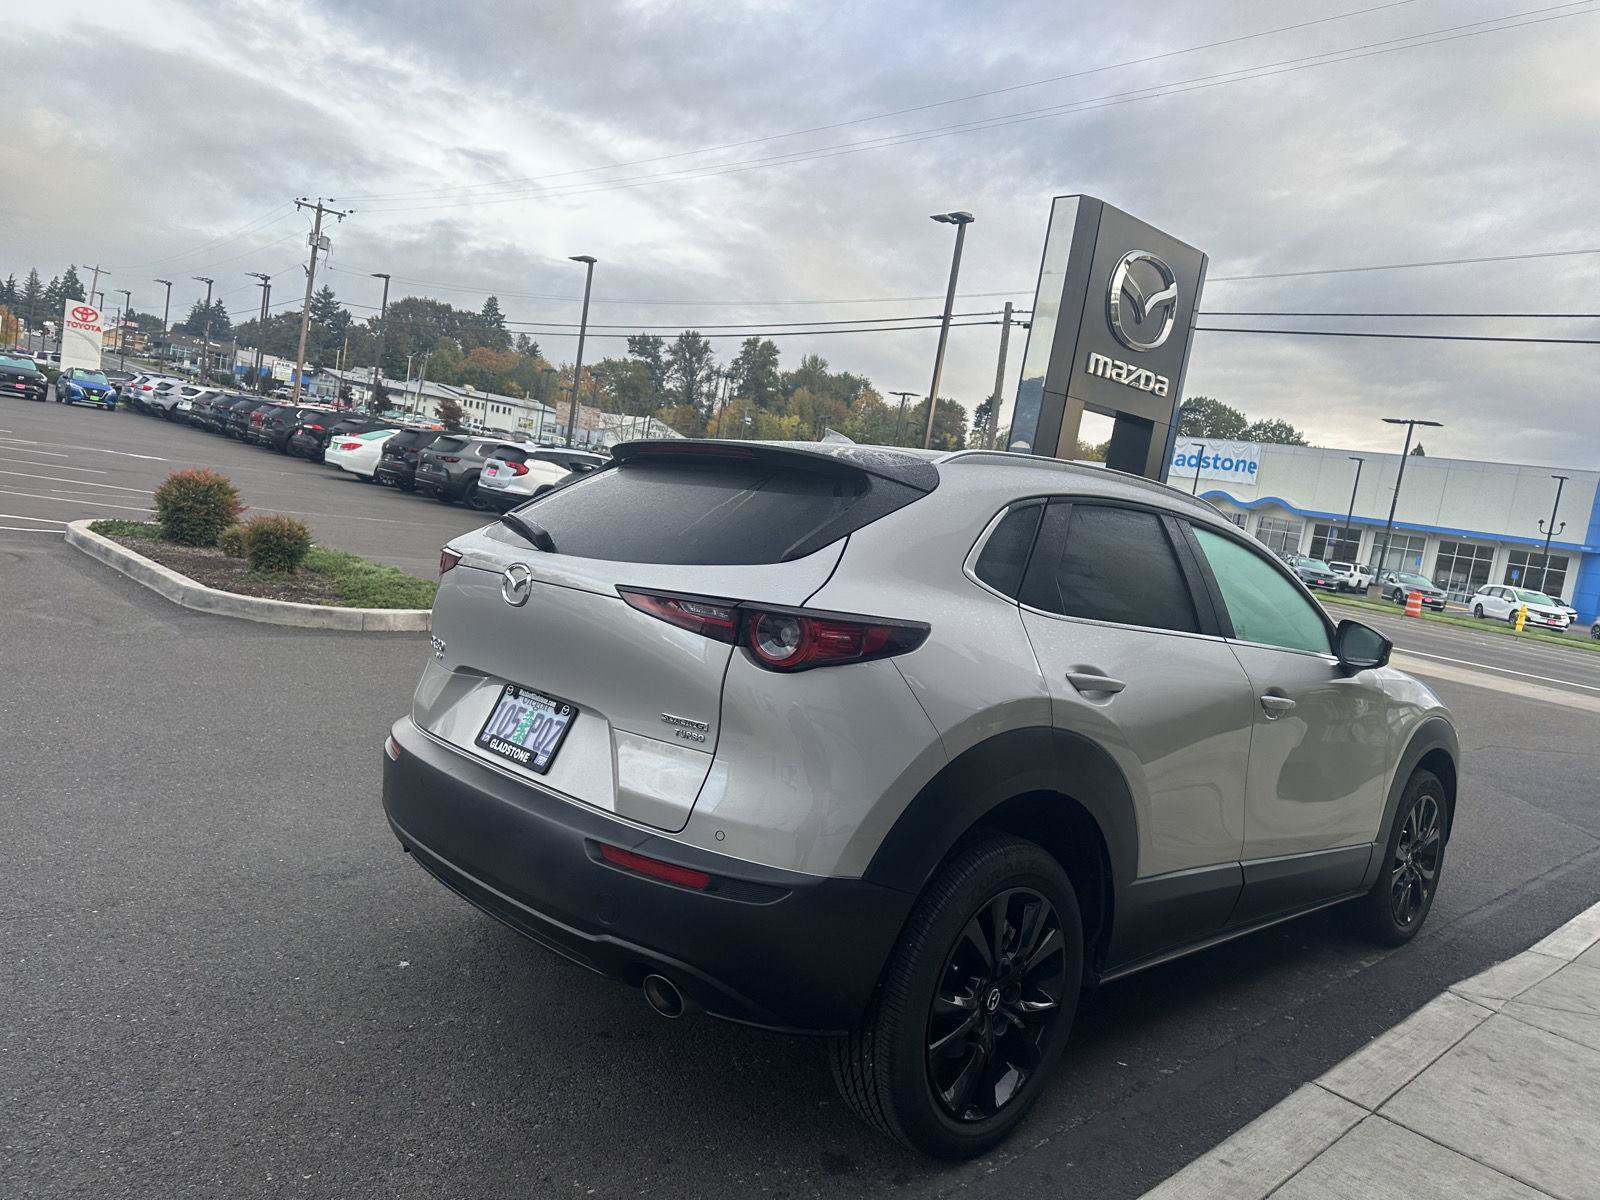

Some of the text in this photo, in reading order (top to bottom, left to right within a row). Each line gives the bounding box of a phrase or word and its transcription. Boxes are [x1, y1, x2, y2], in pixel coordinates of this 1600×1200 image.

[66, 320, 102, 333] TOYOTA
[1087, 352, 1170, 397] mazda
[1171, 446, 1258, 474] ladstone
[488, 701, 527, 739] 105
[675, 728, 705, 742] TURBO
[490, 738, 530, 763] GLADSTONE
